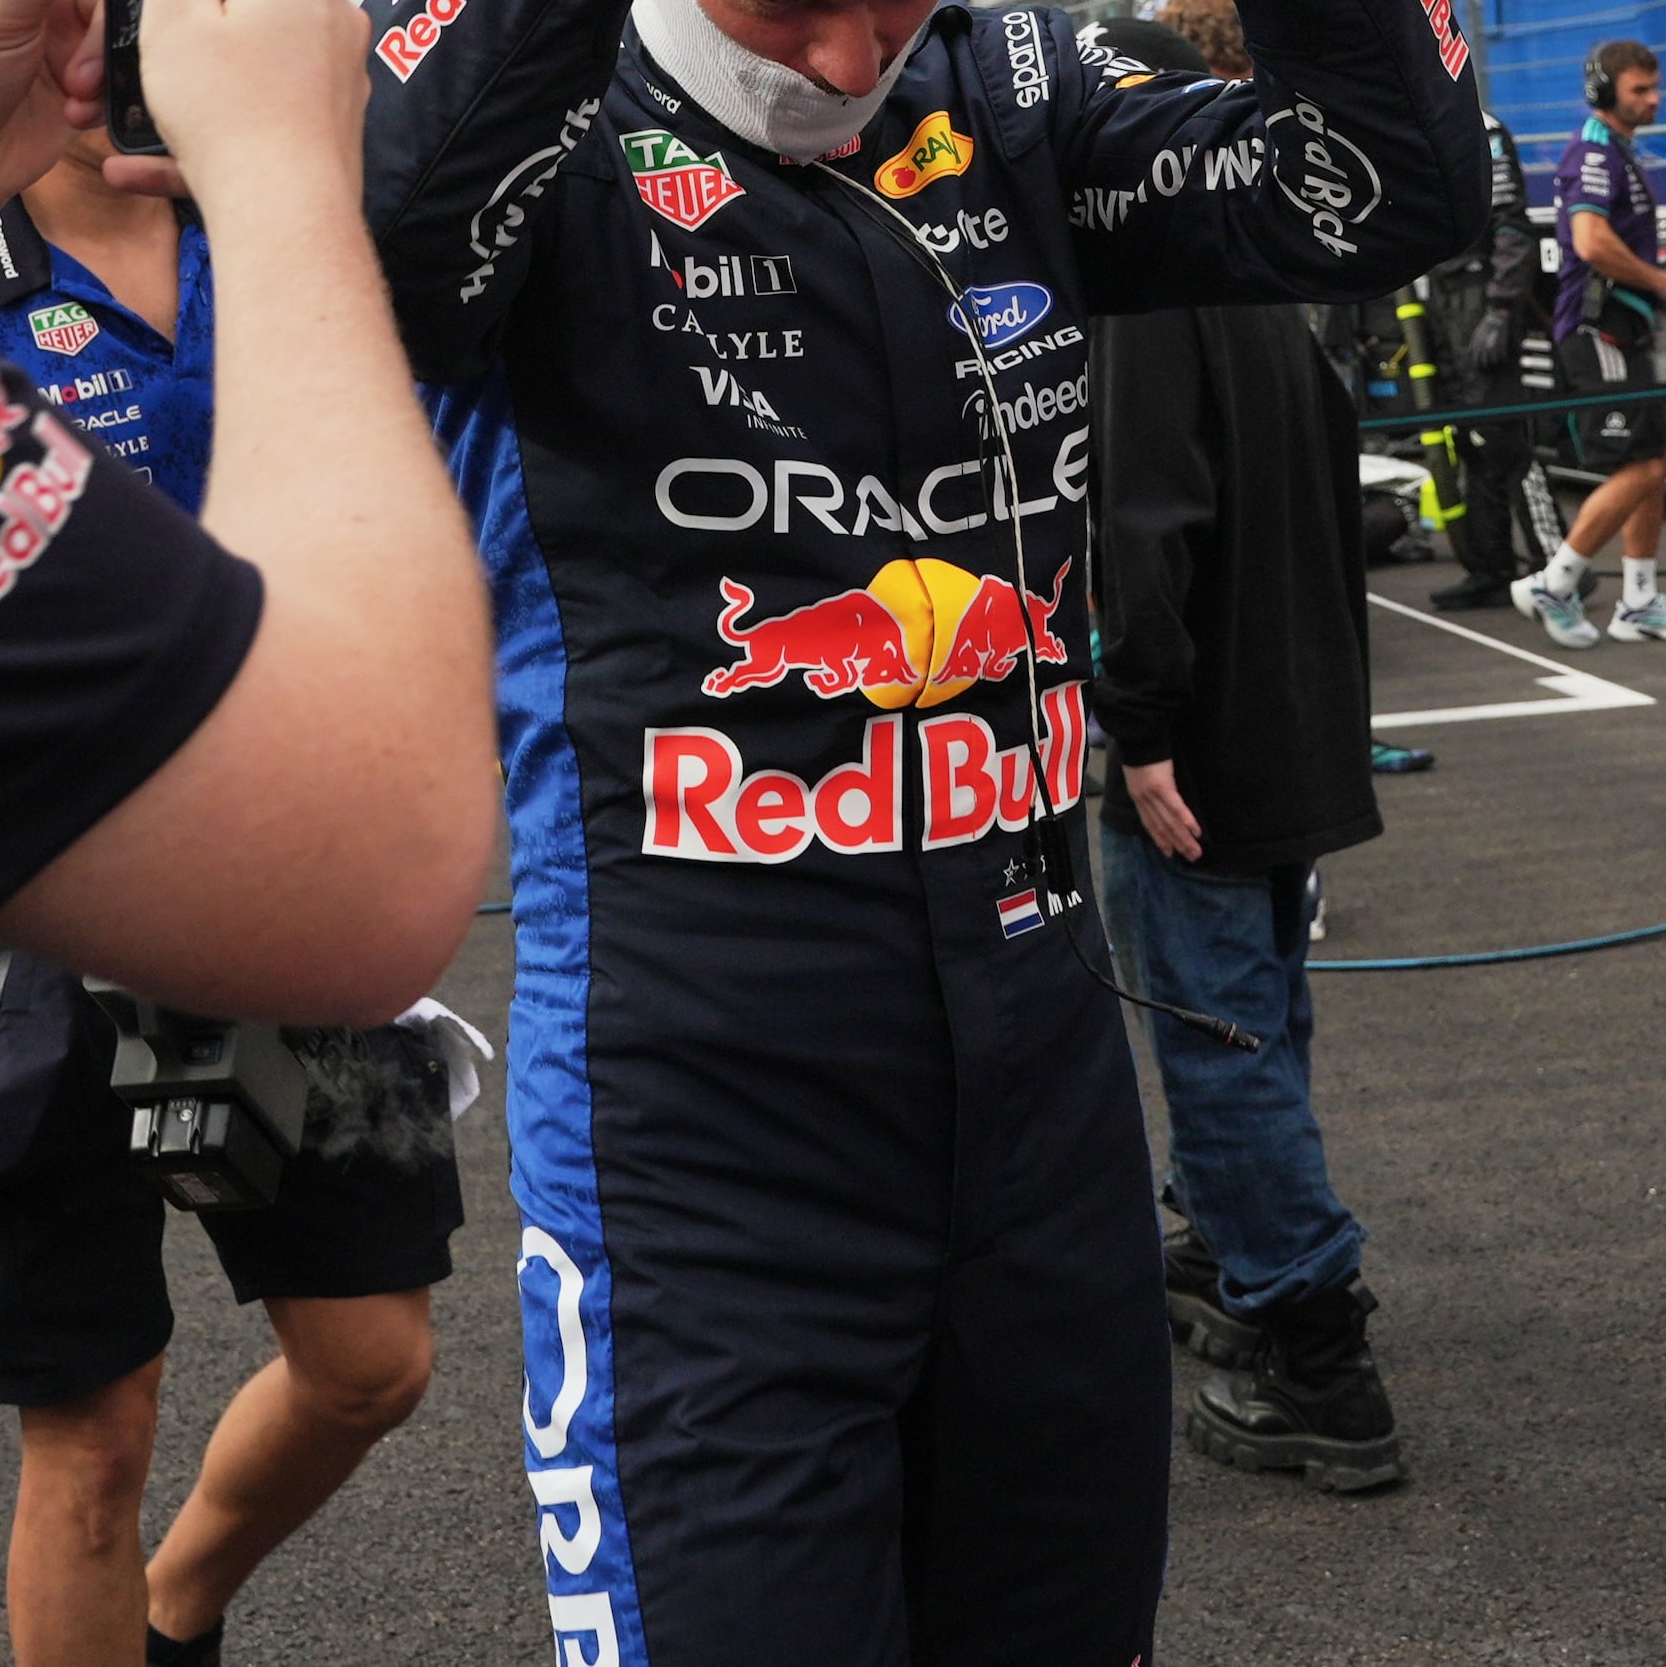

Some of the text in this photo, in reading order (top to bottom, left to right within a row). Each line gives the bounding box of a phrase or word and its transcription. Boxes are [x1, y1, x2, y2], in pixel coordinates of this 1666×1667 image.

[1002, 11, 1049, 108] sparco
[634, 170, 739, 228] HEUER
[34, 305, 90, 331] TAG
[36, 321, 97, 350] HEUER
[652, 303, 804, 361] CALYLE
[969, 294, 1027, 339] Frd
[955, 326, 1084, 379] RACING
[37, 373, 109, 406] Mobil
[76, 405, 142, 431] RACLE
[969, 361, 1089, 441] indeed
[3, 411, 94, 536] Bull
[655, 426, 1089, 541] ORACLE
[641, 679, 1091, 864] Red Bull
